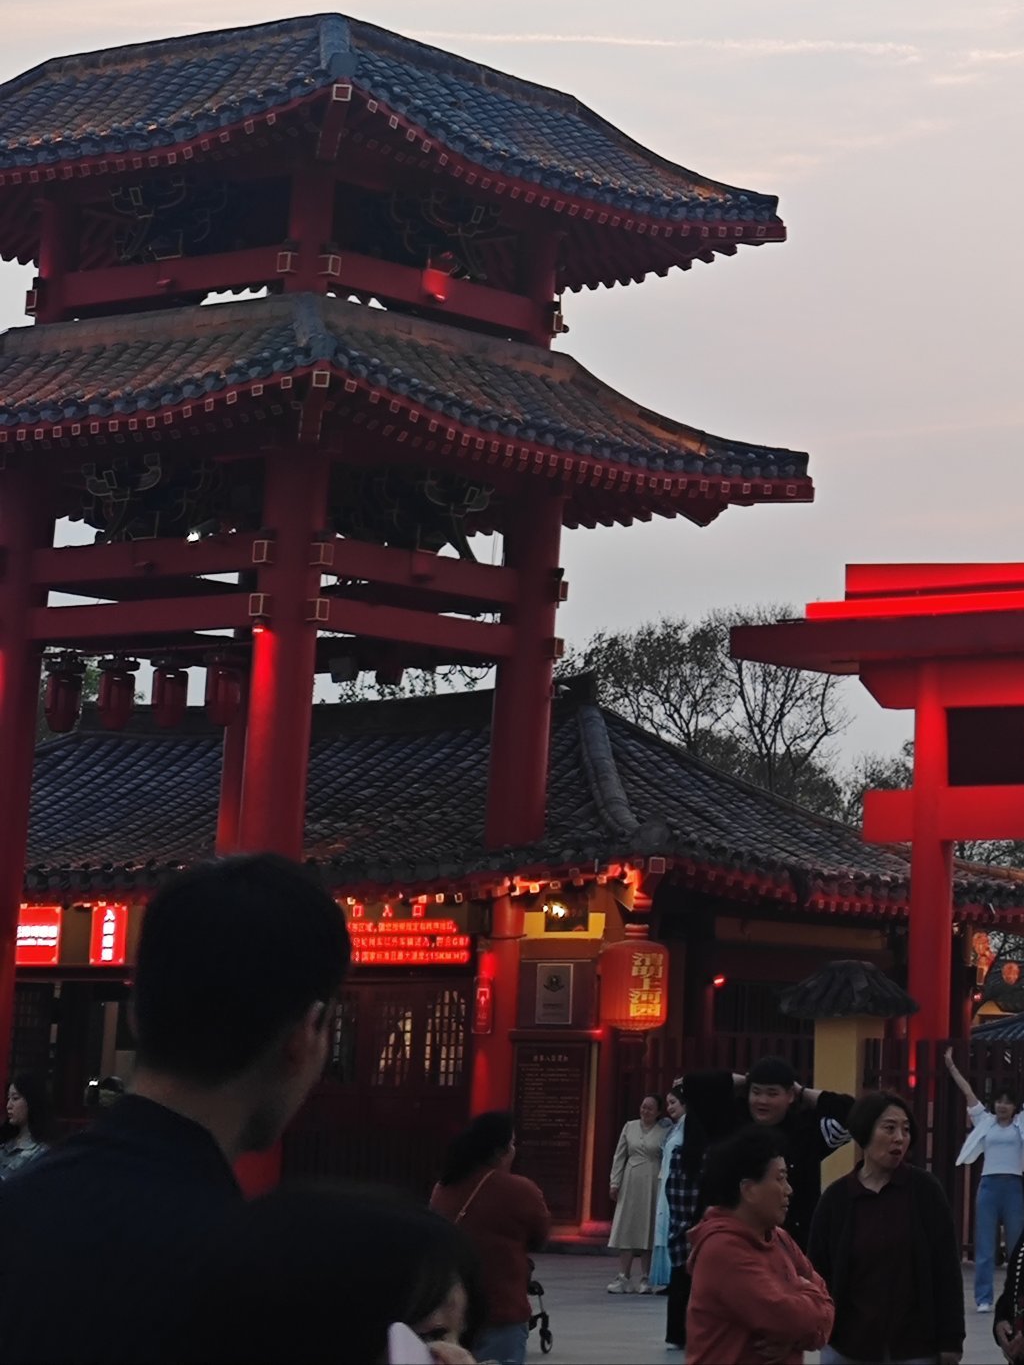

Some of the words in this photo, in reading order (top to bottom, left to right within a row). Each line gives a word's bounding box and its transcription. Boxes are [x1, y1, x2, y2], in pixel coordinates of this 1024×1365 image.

[628, 952, 664, 1017] 清明上河园
